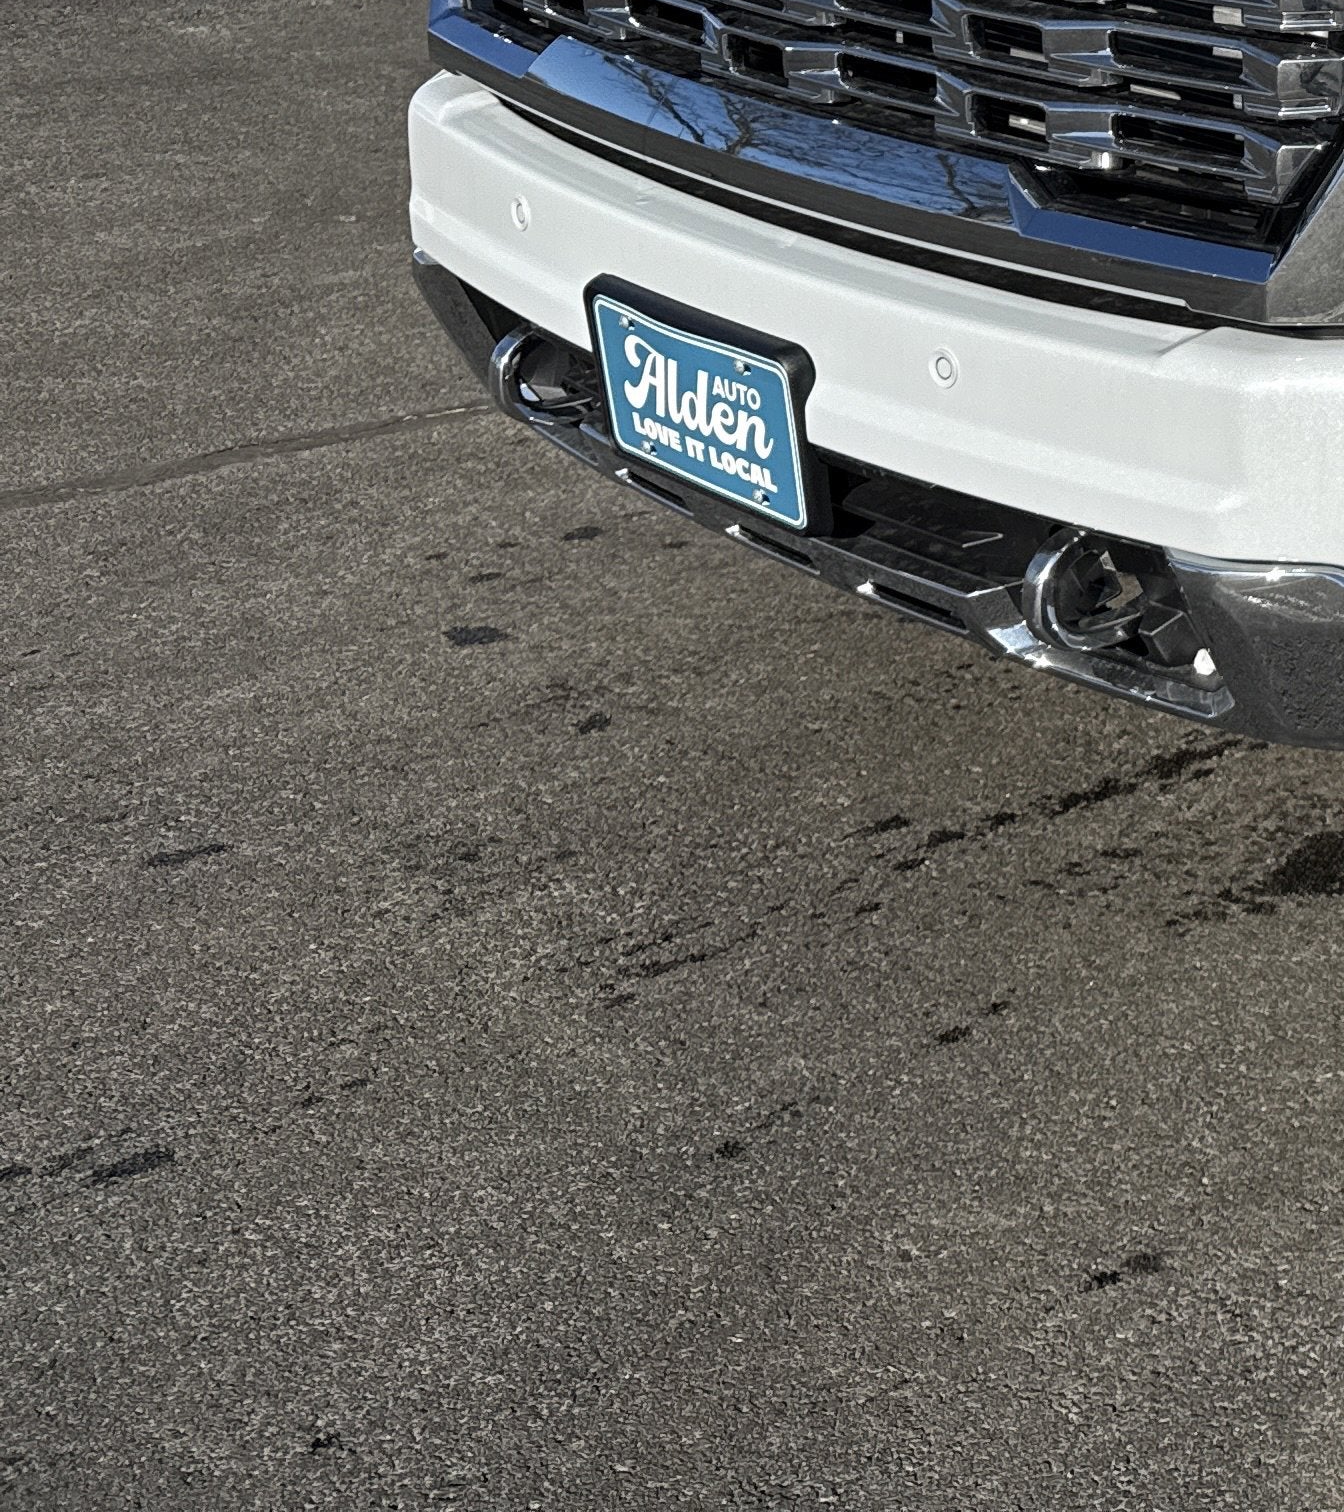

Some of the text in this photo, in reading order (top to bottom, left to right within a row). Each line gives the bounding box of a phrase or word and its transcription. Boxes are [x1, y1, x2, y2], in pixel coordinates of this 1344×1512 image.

[624, 334, 774, 460] Alden
[712, 375, 762, 410] AUTO
[632, 412, 778, 494] LOVE IT LOCAL
